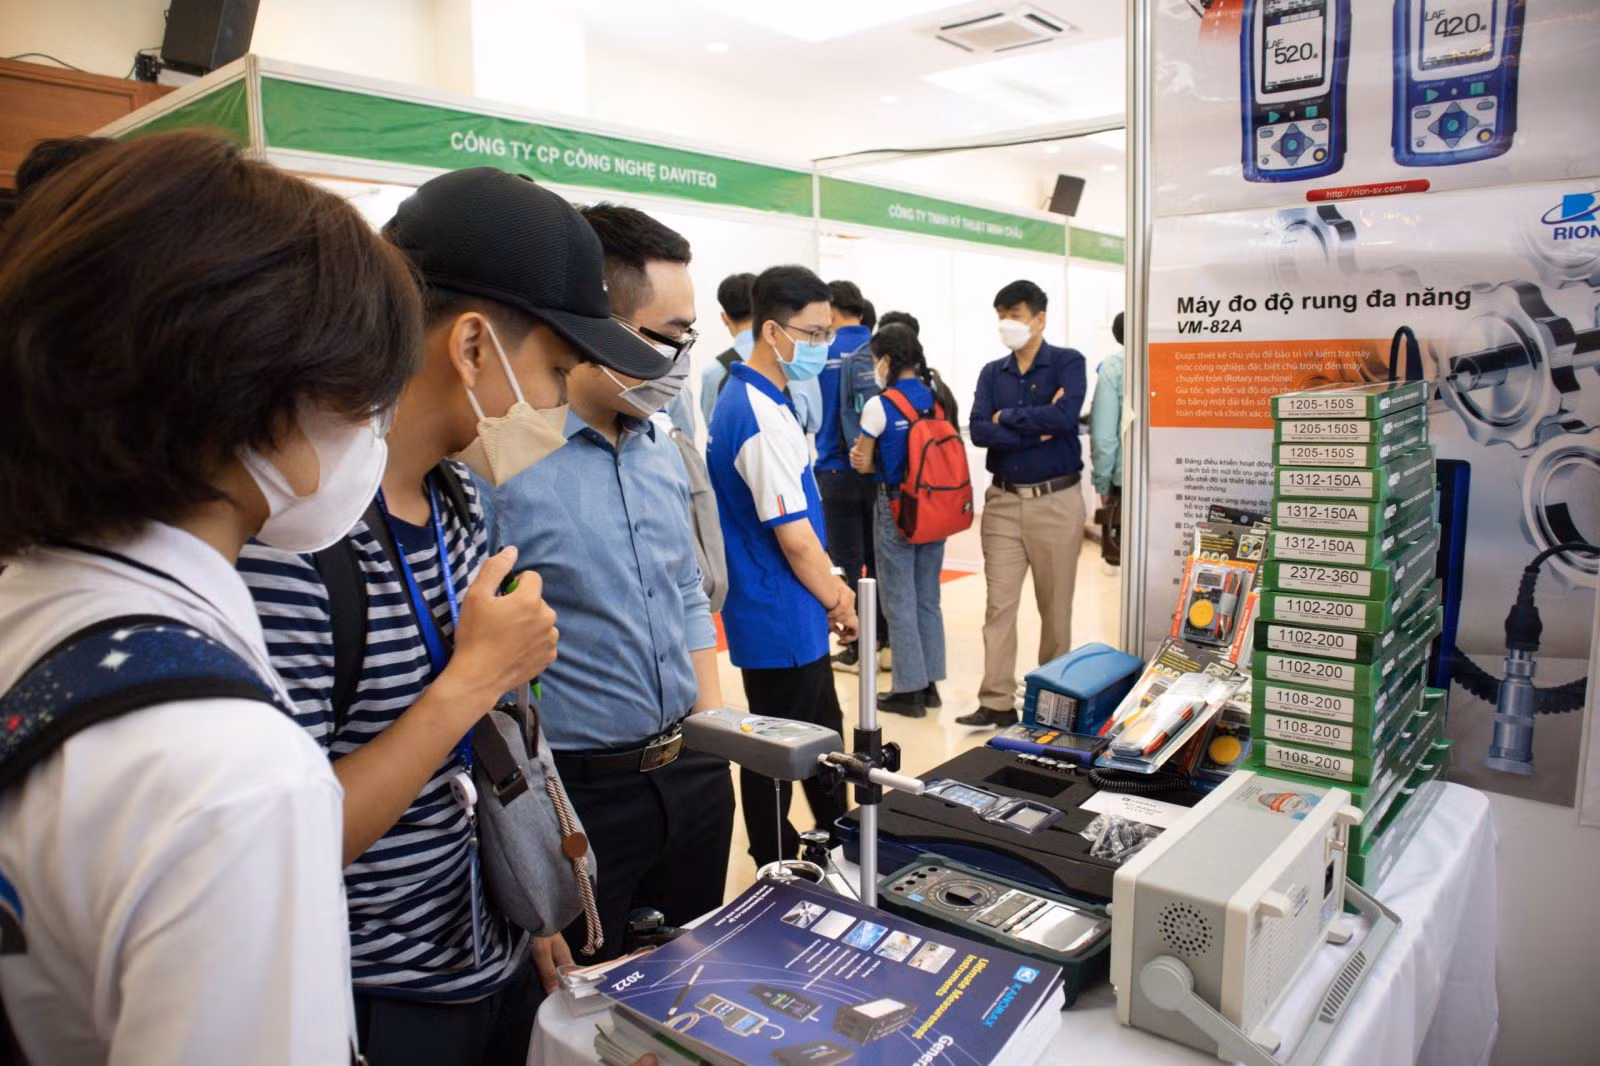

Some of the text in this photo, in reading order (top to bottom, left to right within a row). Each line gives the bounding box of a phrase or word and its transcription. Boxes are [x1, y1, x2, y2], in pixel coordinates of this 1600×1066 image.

[1424, 10, 1446, 22] LAF
[1265, 38, 1284, 50] LAF
[450, 130, 718, 188] CÔNG TY CP CÔNG NGHỆ DAVITEQ
[1326, 184, 1406, 198] http://rion-sv.com/
[1553, 225, 1600, 240] RION
[1177, 288, 1471, 317] Máy đo độ rung đa năng
[1177, 320, 1242, 334] VM-82A
[1290, 398, 1354, 409] 1205-150S
[1293, 424, 1358, 433] 1205-150S
[1291, 448, 1354, 458] 1205-150S
[1289, 474, 1361, 486] 1312-150A
[1287, 505, 1358, 520] 1312-150A
[1285, 536, 1355, 552] 1312-150A
[1290, 566, 1358, 583] 2372-360
[1287, 599, 1353, 616] 1102-200
[1280, 629, 1344, 647] 1102-200
[1278, 659, 1342, 678] 1102-200
[1277, 691, 1341, 710] 1108-200
[1277, 719, 1340, 738] 1108-200
[1277, 750, 1340, 770] 1108-200
[611, 971, 645, 991] 2022
[936, 954, 977, 996] Instruments
[912, 958, 989, 1039] Ultimate Measurement
[983, 982, 1022, 1028] KANOMAX
